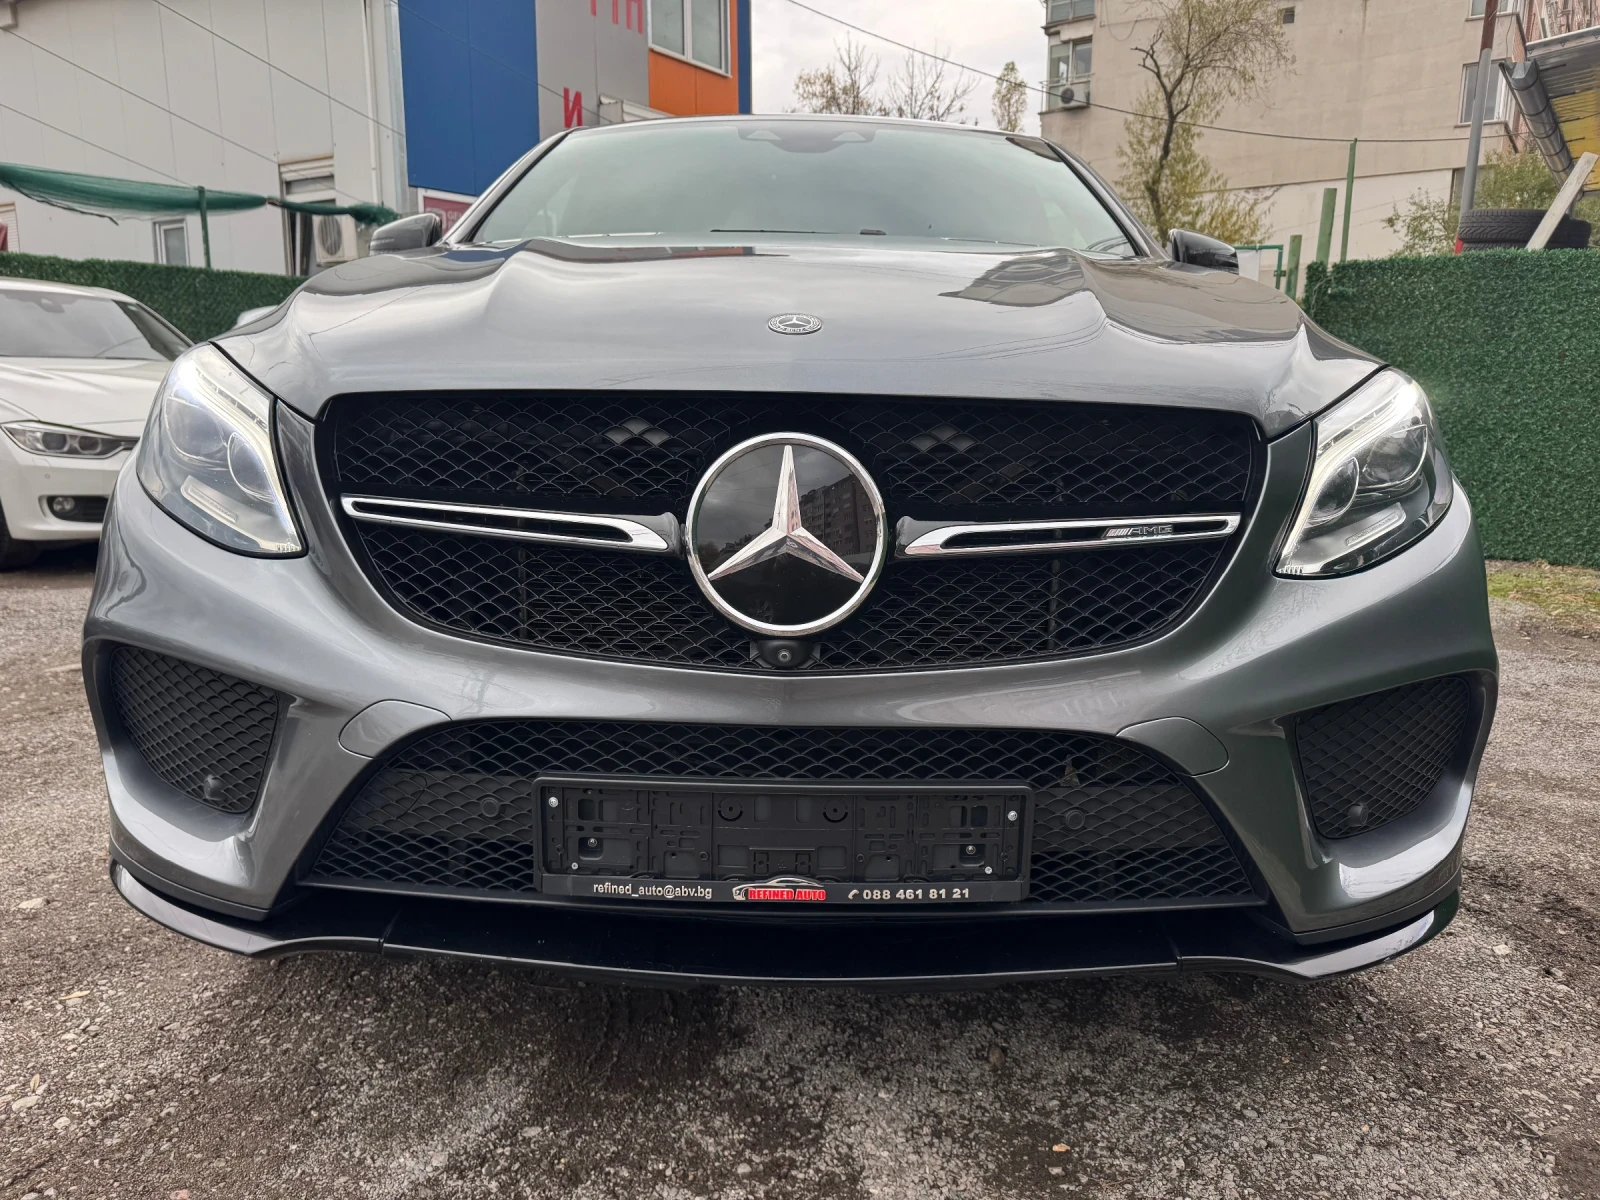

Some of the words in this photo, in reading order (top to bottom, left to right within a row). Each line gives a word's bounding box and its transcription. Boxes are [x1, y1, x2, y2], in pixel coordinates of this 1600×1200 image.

[1128, 524, 1173, 535] AMG
[593, 882, 713, 899] refined_auto@abv.bg
[748, 888, 795, 900] REFINED
[795, 888, 826, 901] AUTO
[862, 889, 891, 900] 088
[895, 889, 923, 900] 461
[928, 888, 947, 899] 81
[952, 888, 970, 899] 21
